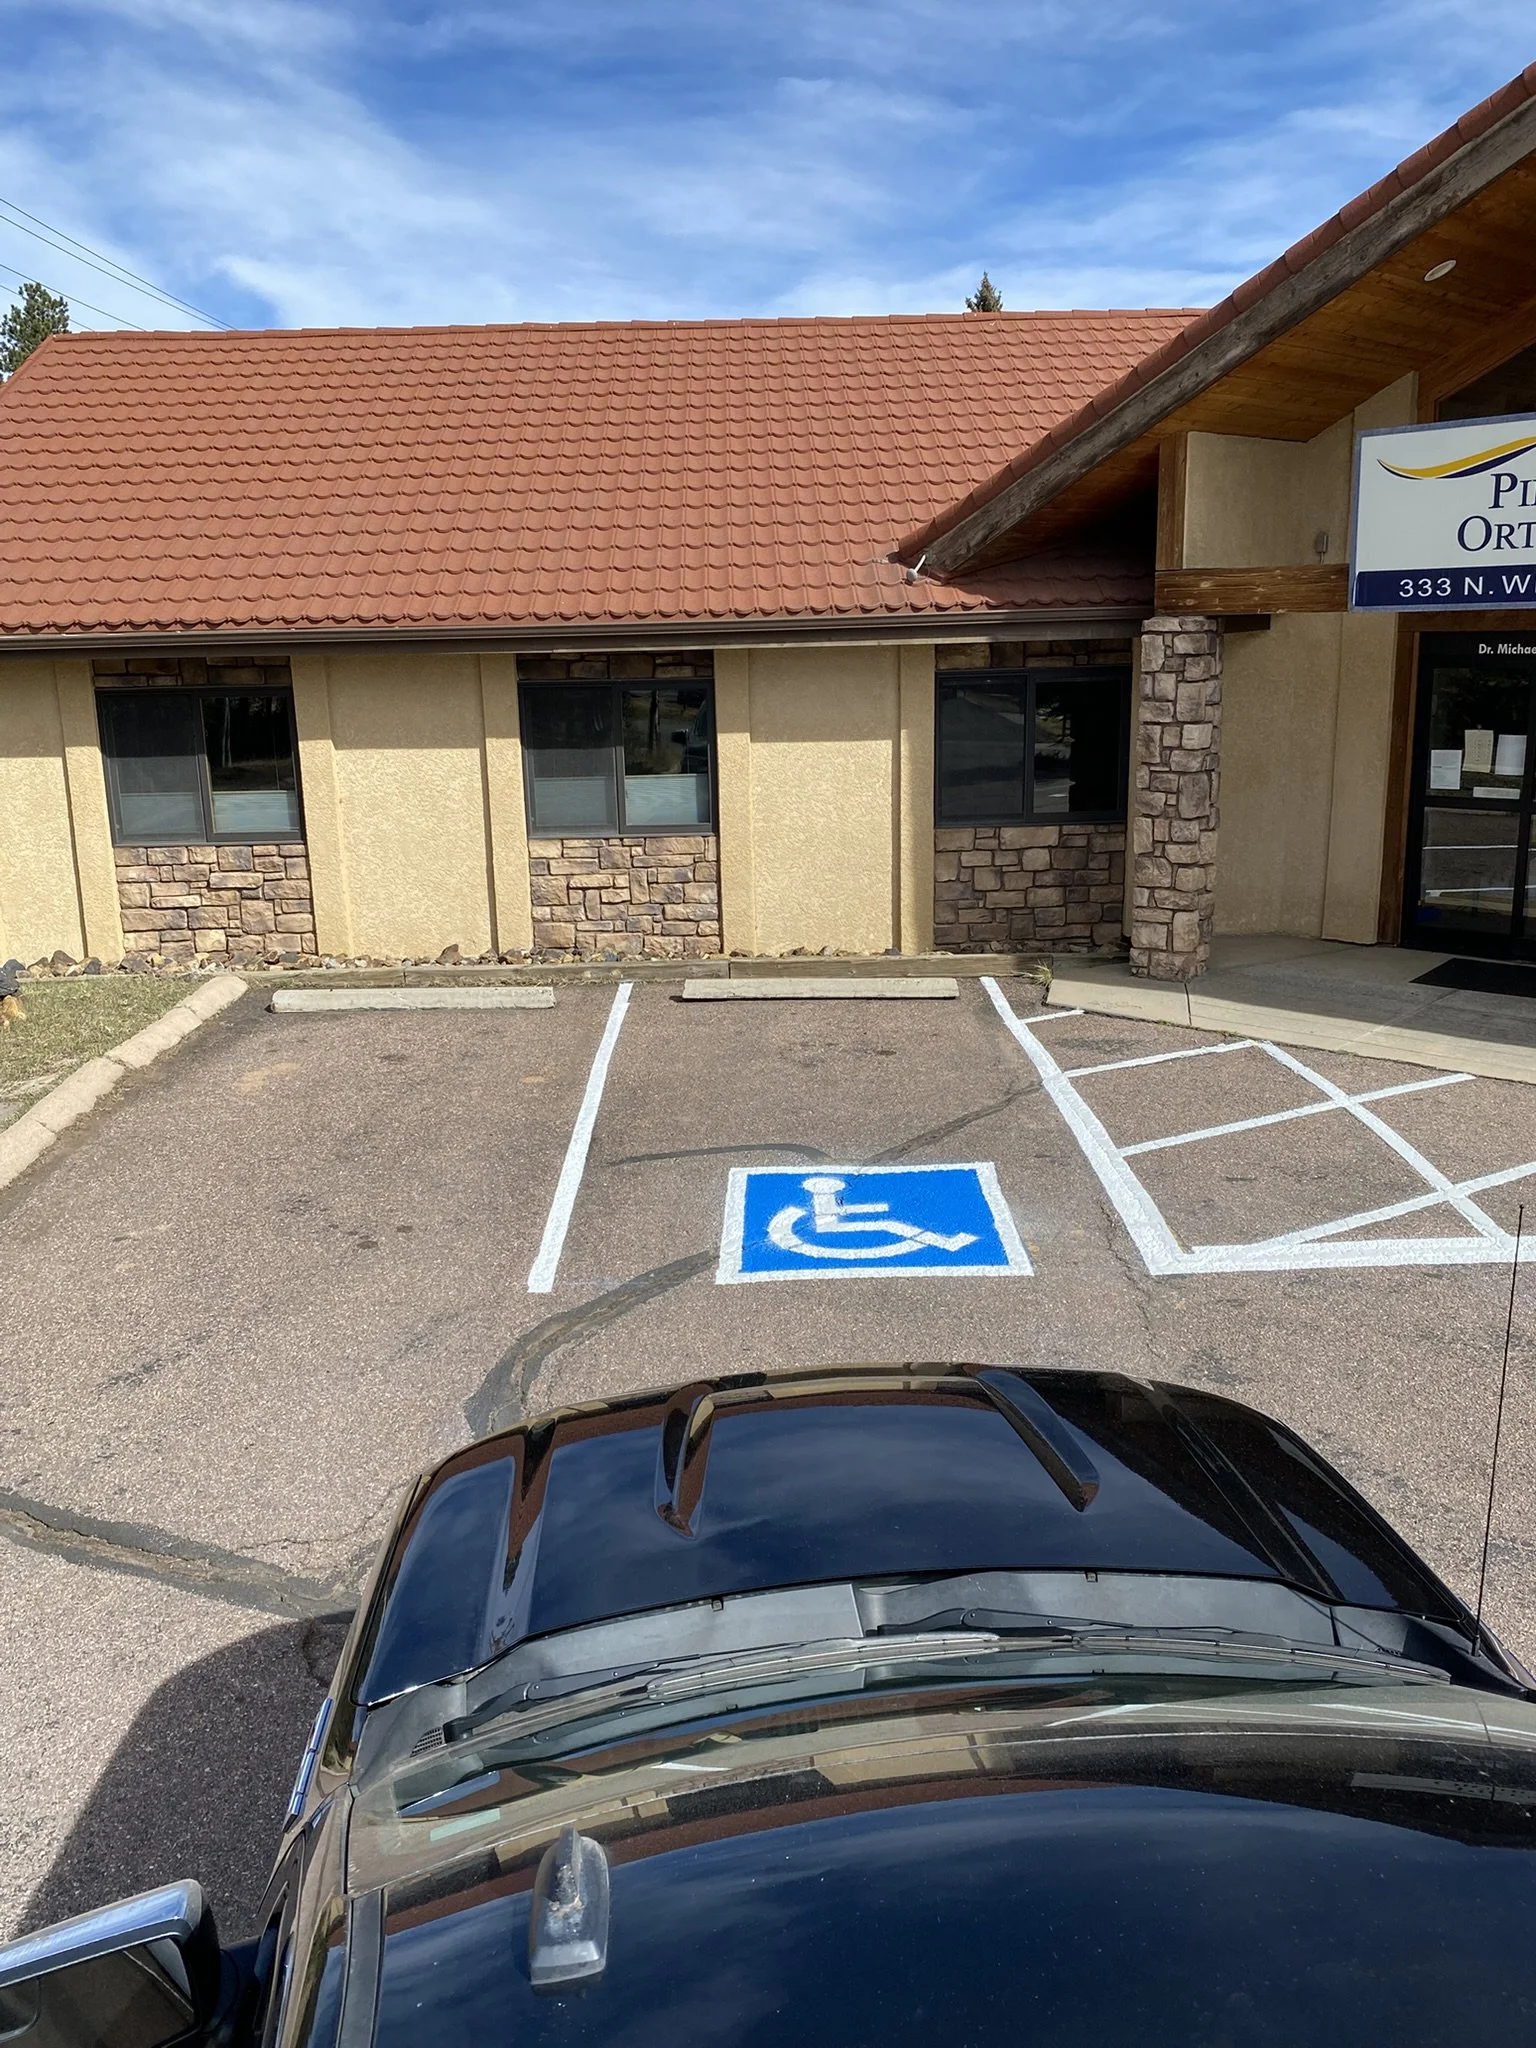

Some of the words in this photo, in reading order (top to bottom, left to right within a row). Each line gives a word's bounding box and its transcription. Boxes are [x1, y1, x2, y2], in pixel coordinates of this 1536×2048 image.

[1488, 473, 1536, 509] PI
[1399, 578, 1451, 597] 333
[1464, 576, 1494, 595] N.
[1502, 575, 1536, 594] W
[1479, 643, 1494, 654] Dr.
